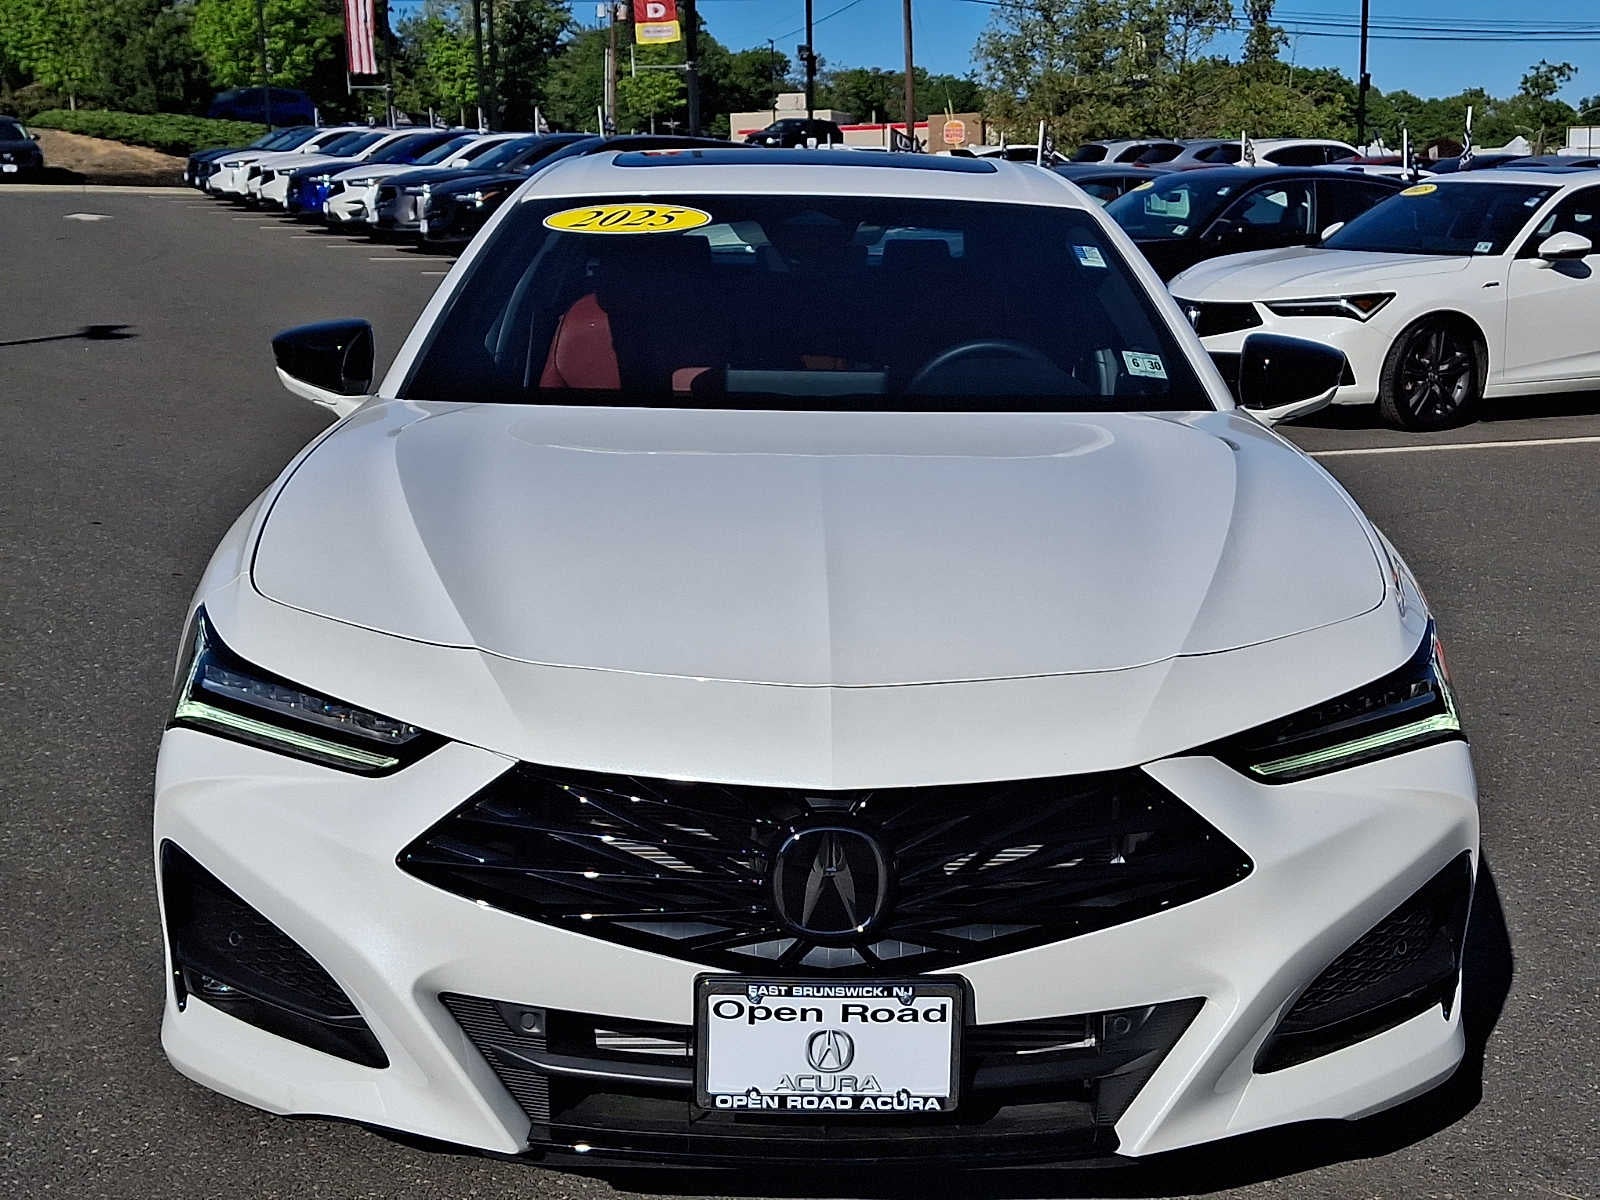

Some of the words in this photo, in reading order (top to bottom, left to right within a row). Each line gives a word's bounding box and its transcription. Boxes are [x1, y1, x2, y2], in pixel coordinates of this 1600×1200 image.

[568, 209, 686, 228] 2025
[1131, 358, 1140, 368] 6
[1147, 360, 1161, 371] 30
[748, 985, 788, 996] EAST
[892, 987, 913, 997] NJ
[712, 1000, 823, 1025] Open
[841, 1003, 947, 1023] Road
[774, 1073, 882, 1093] ACURA
[715, 1095, 779, 1109] OPEN
[786, 1096, 853, 1110] ROAD
[860, 1096, 941, 1111] ACURA
